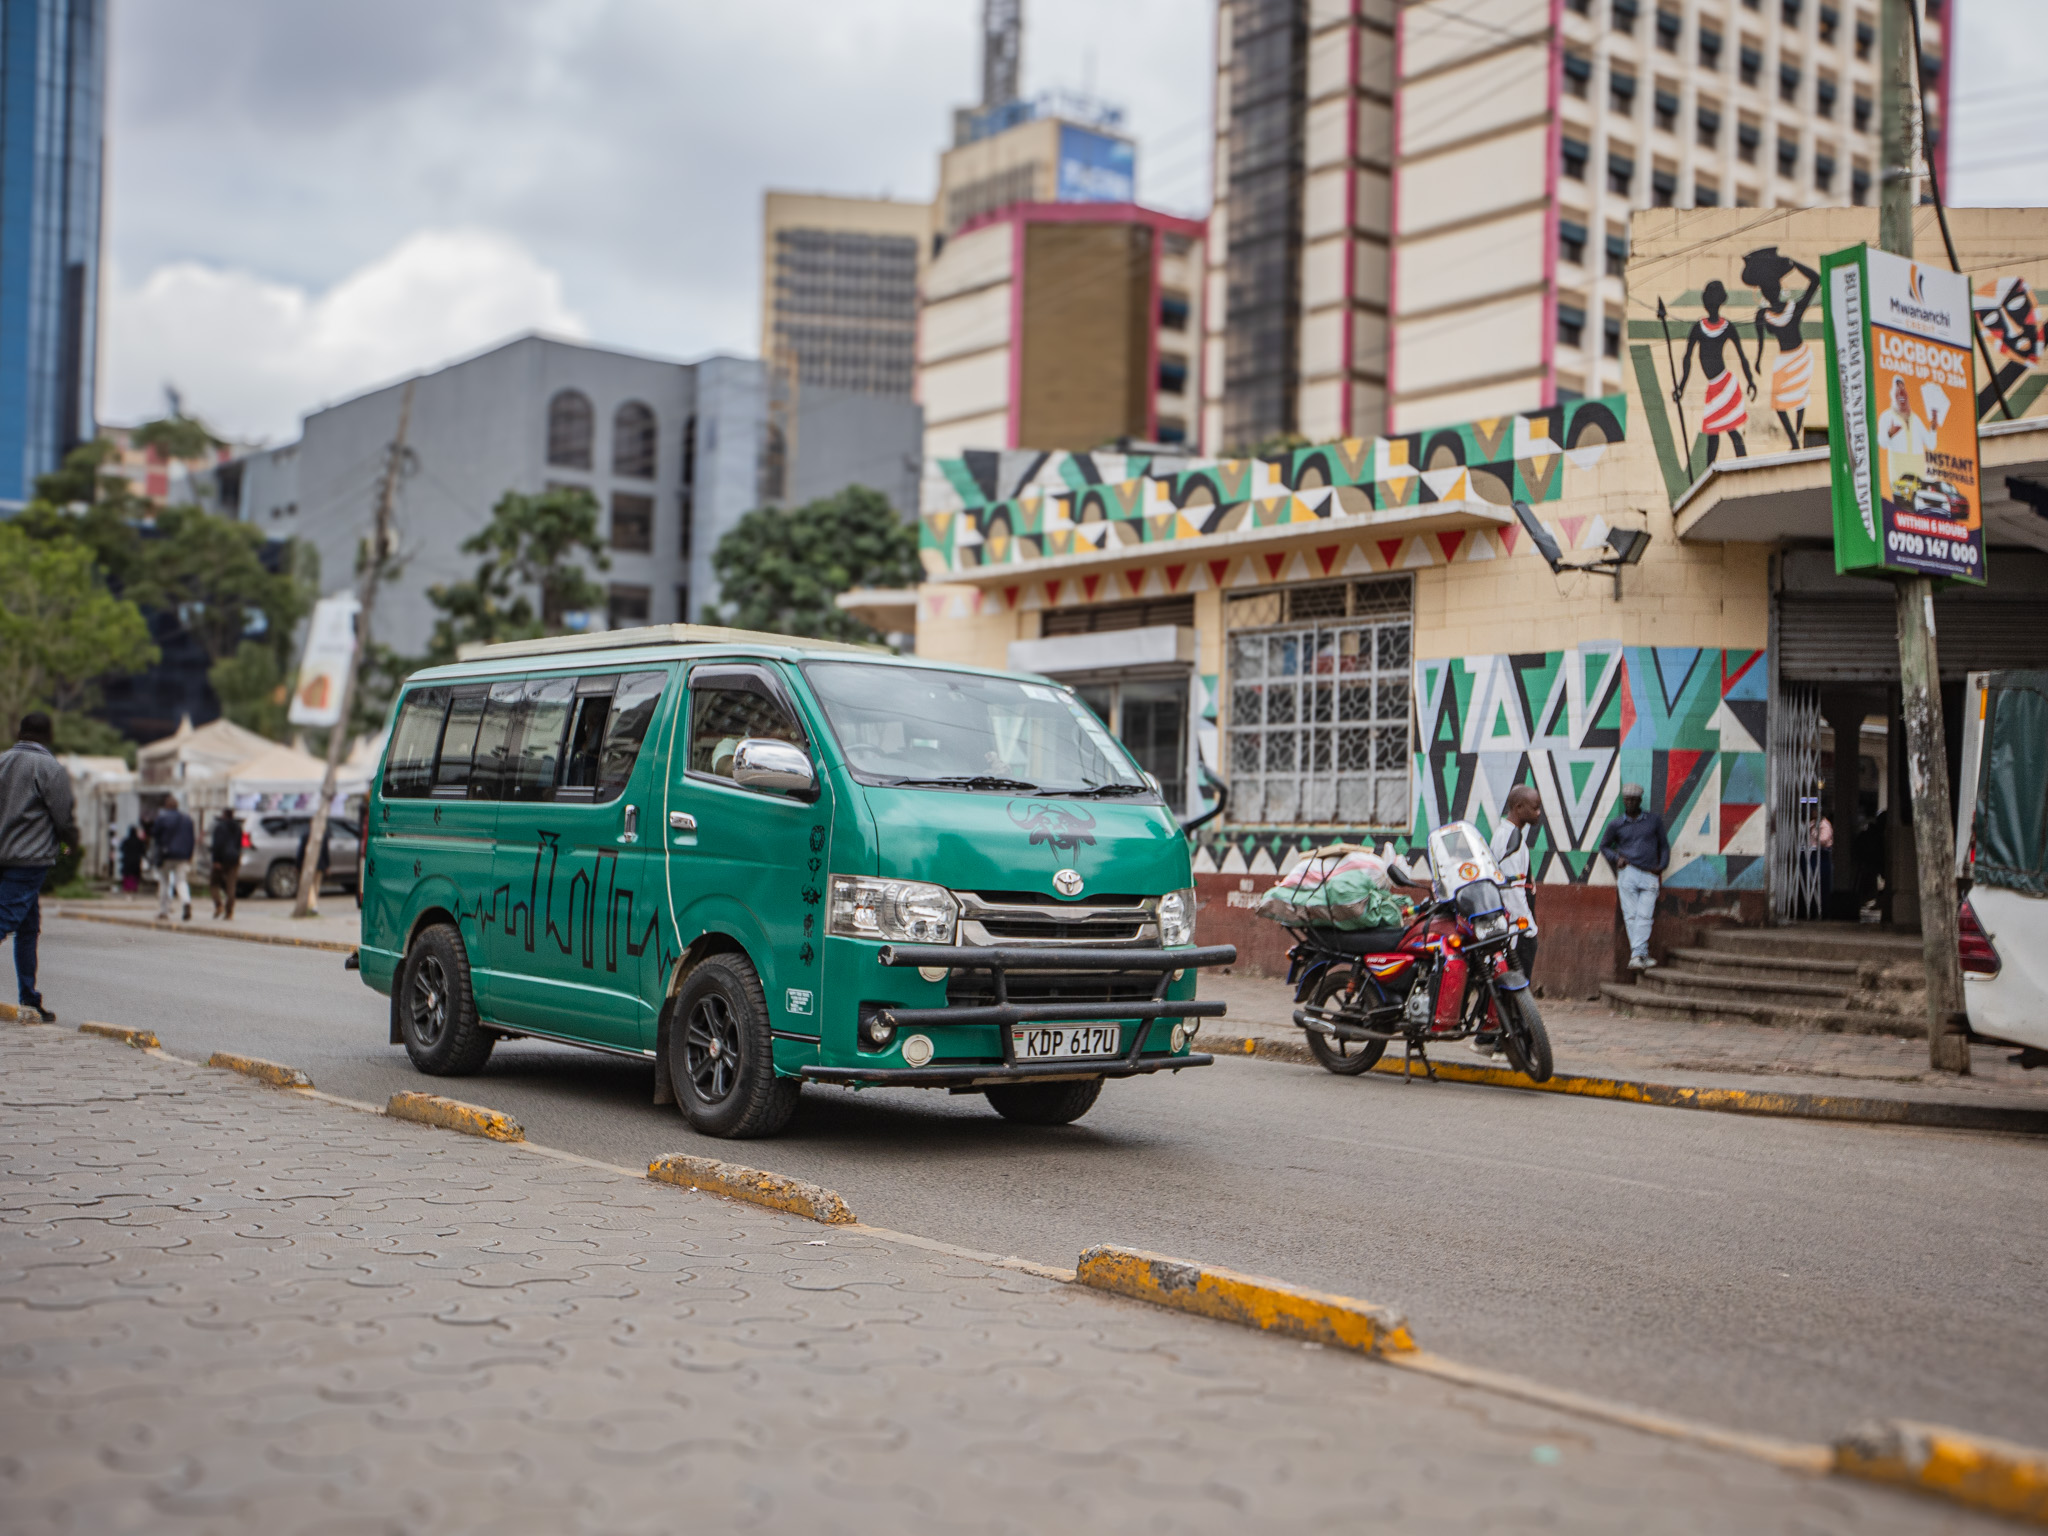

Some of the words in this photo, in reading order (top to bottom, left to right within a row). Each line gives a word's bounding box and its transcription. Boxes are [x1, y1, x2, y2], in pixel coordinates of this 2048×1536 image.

[1844, 271, 1861, 367] BULLFIRM
[1890, 297, 1950, 327] Mwananchi
[1879, 332, 1965, 375] LOGBOOK
[1879, 354, 1914, 376] LOANS
[1915, 365, 1930, 379] UP
[1931, 368, 1946, 384] TO
[1850, 369, 1865, 467] VENTURES
[1925, 451, 1973, 472] INSTANT
[1896, 513, 1930, 532] WITHIN
[1938, 521, 1969, 539] HOURS
[1888, 530, 1924, 556] 0709
[1925, 536, 1949, 560] 147
[1951, 541, 1978, 565] 000
[1027, 1029, 1063, 1056] KDP
[1070, 1028, 1115, 1054] 617U
